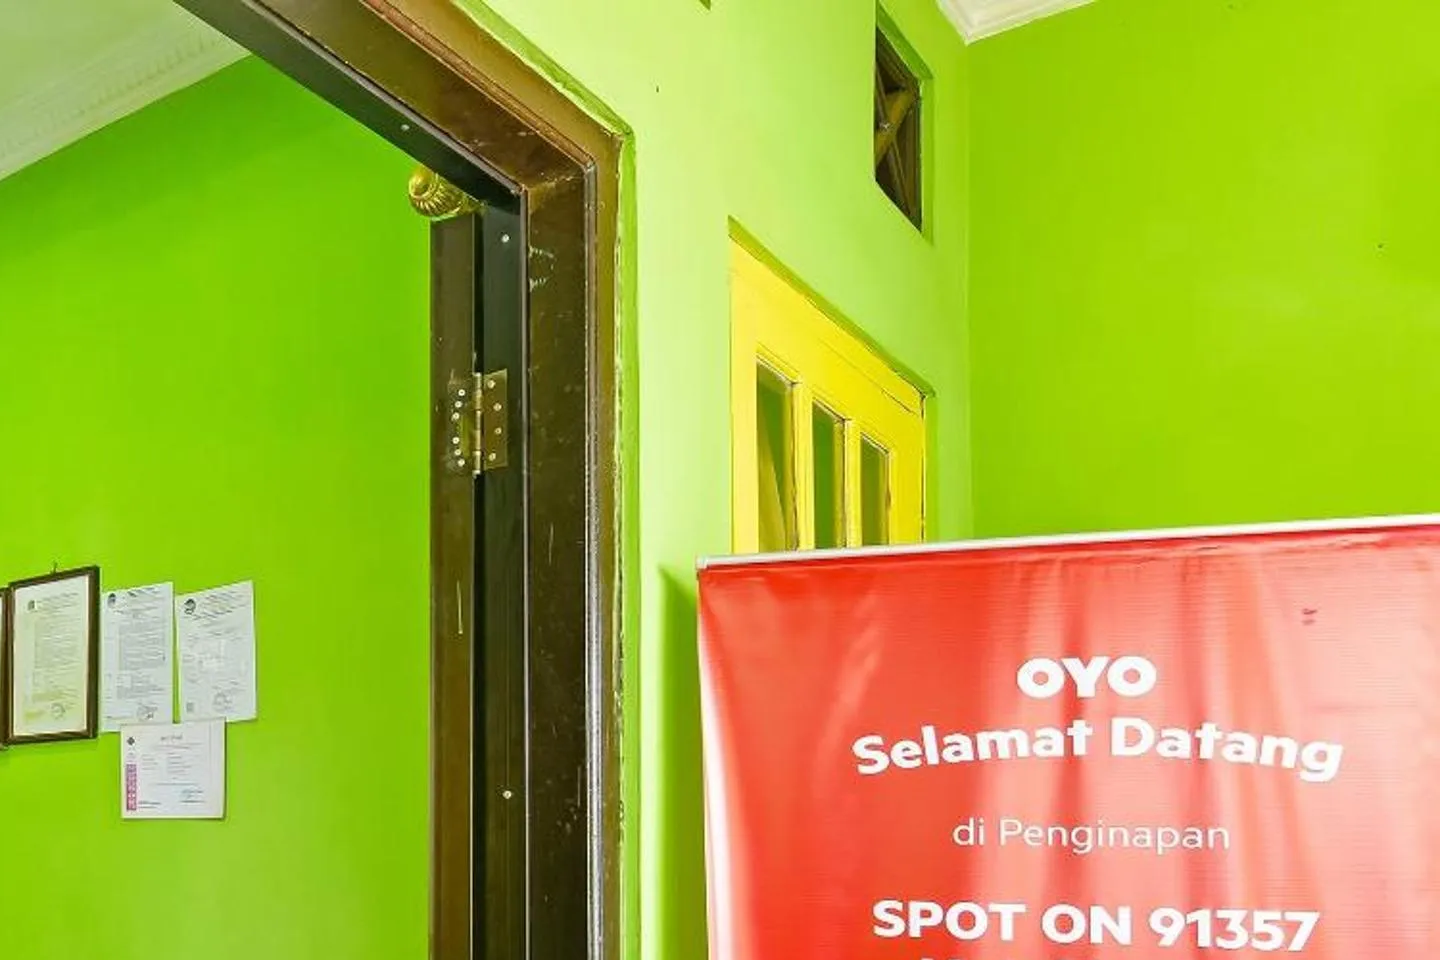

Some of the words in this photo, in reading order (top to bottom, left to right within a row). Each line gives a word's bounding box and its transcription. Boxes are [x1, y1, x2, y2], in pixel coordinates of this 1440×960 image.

[1017, 656, 1158, 698] OYO
[852, 719, 1094, 776] Selamat
[1112, 717, 1344, 783] Datang
[952, 818, 986, 847] di
[1000, 818, 1231, 855] Penginapan
[872, 900, 1027, 942] SPOT
[1041, 904, 1133, 947] ON
[1149, 907, 1321, 953] 91357
